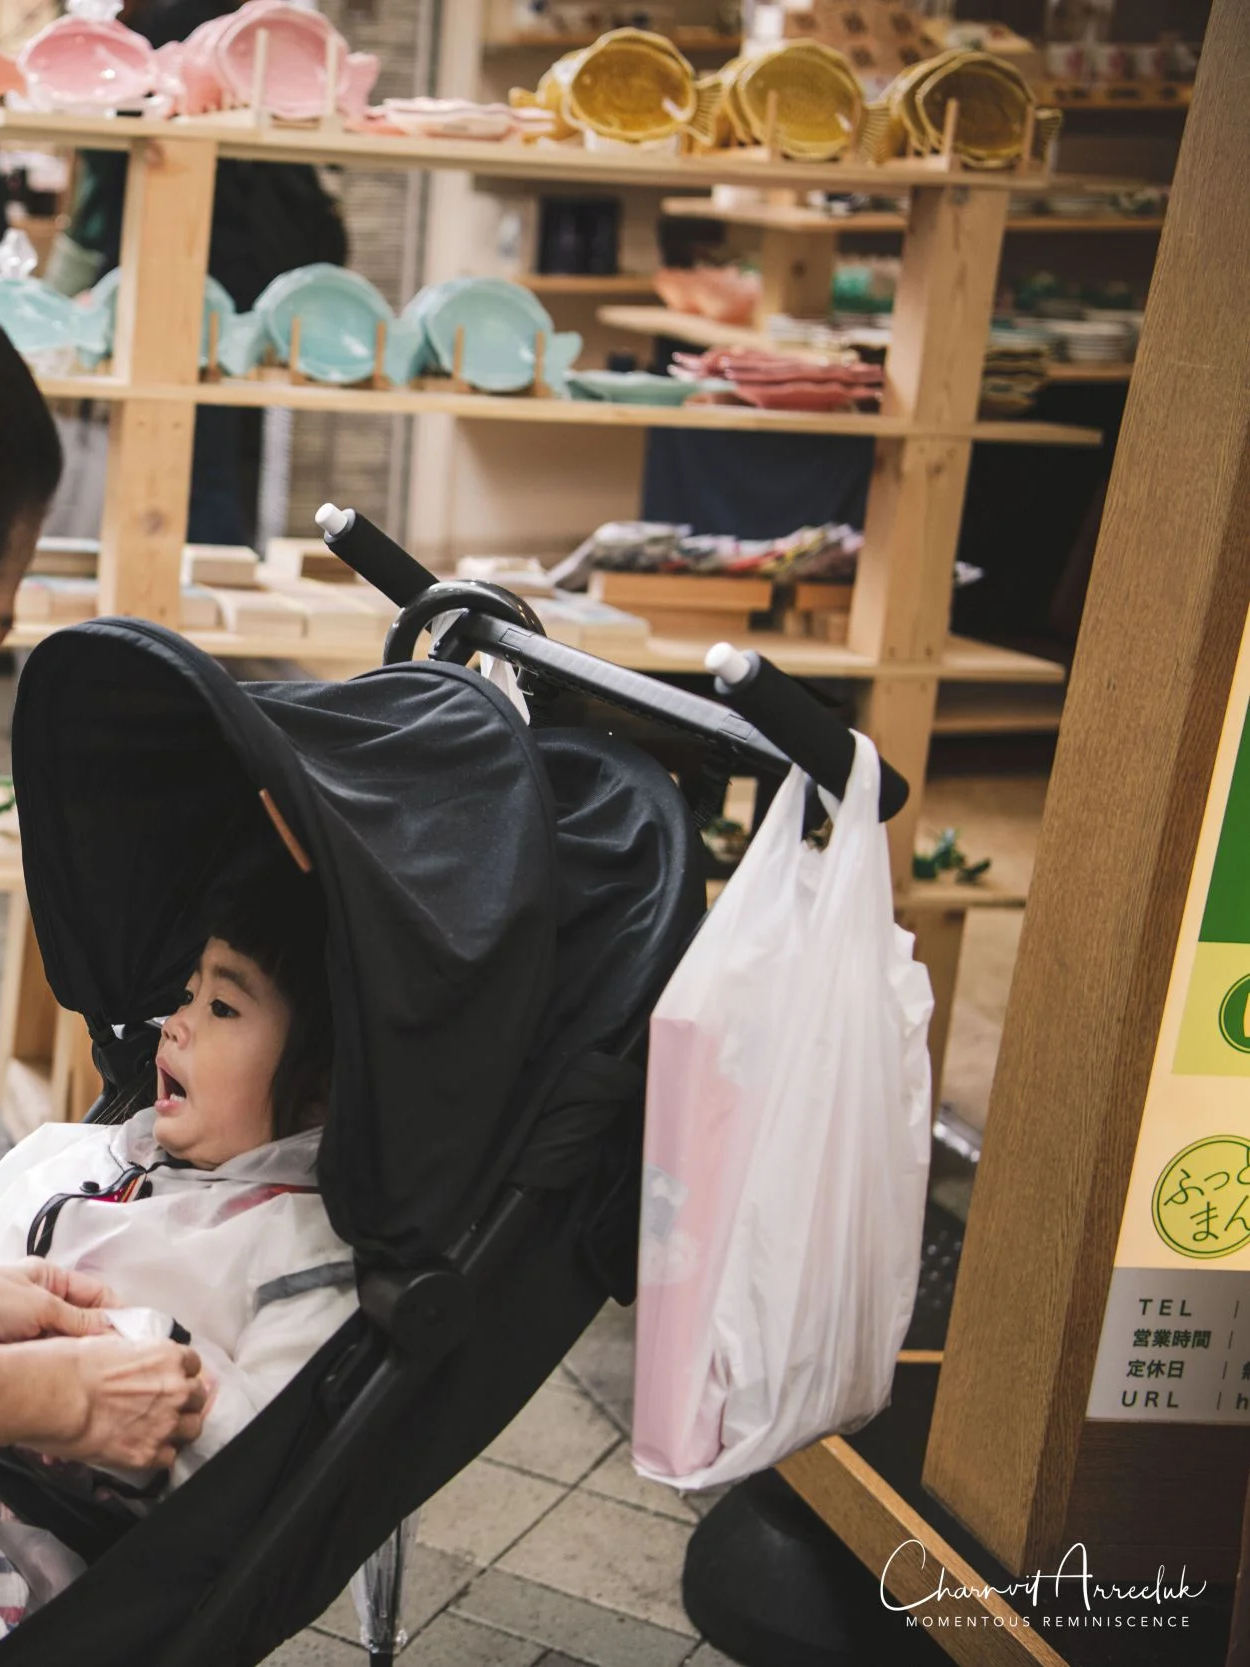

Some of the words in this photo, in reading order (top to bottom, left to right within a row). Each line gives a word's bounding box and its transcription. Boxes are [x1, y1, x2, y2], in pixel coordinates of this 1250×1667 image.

[1139, 1299, 1192, 1317] TEL
[1132, 1328, 1212, 1349] 営業時間
[1126, 1359, 1185, 1379] 定休日
[1121, 1390, 1179, 1408] URL
